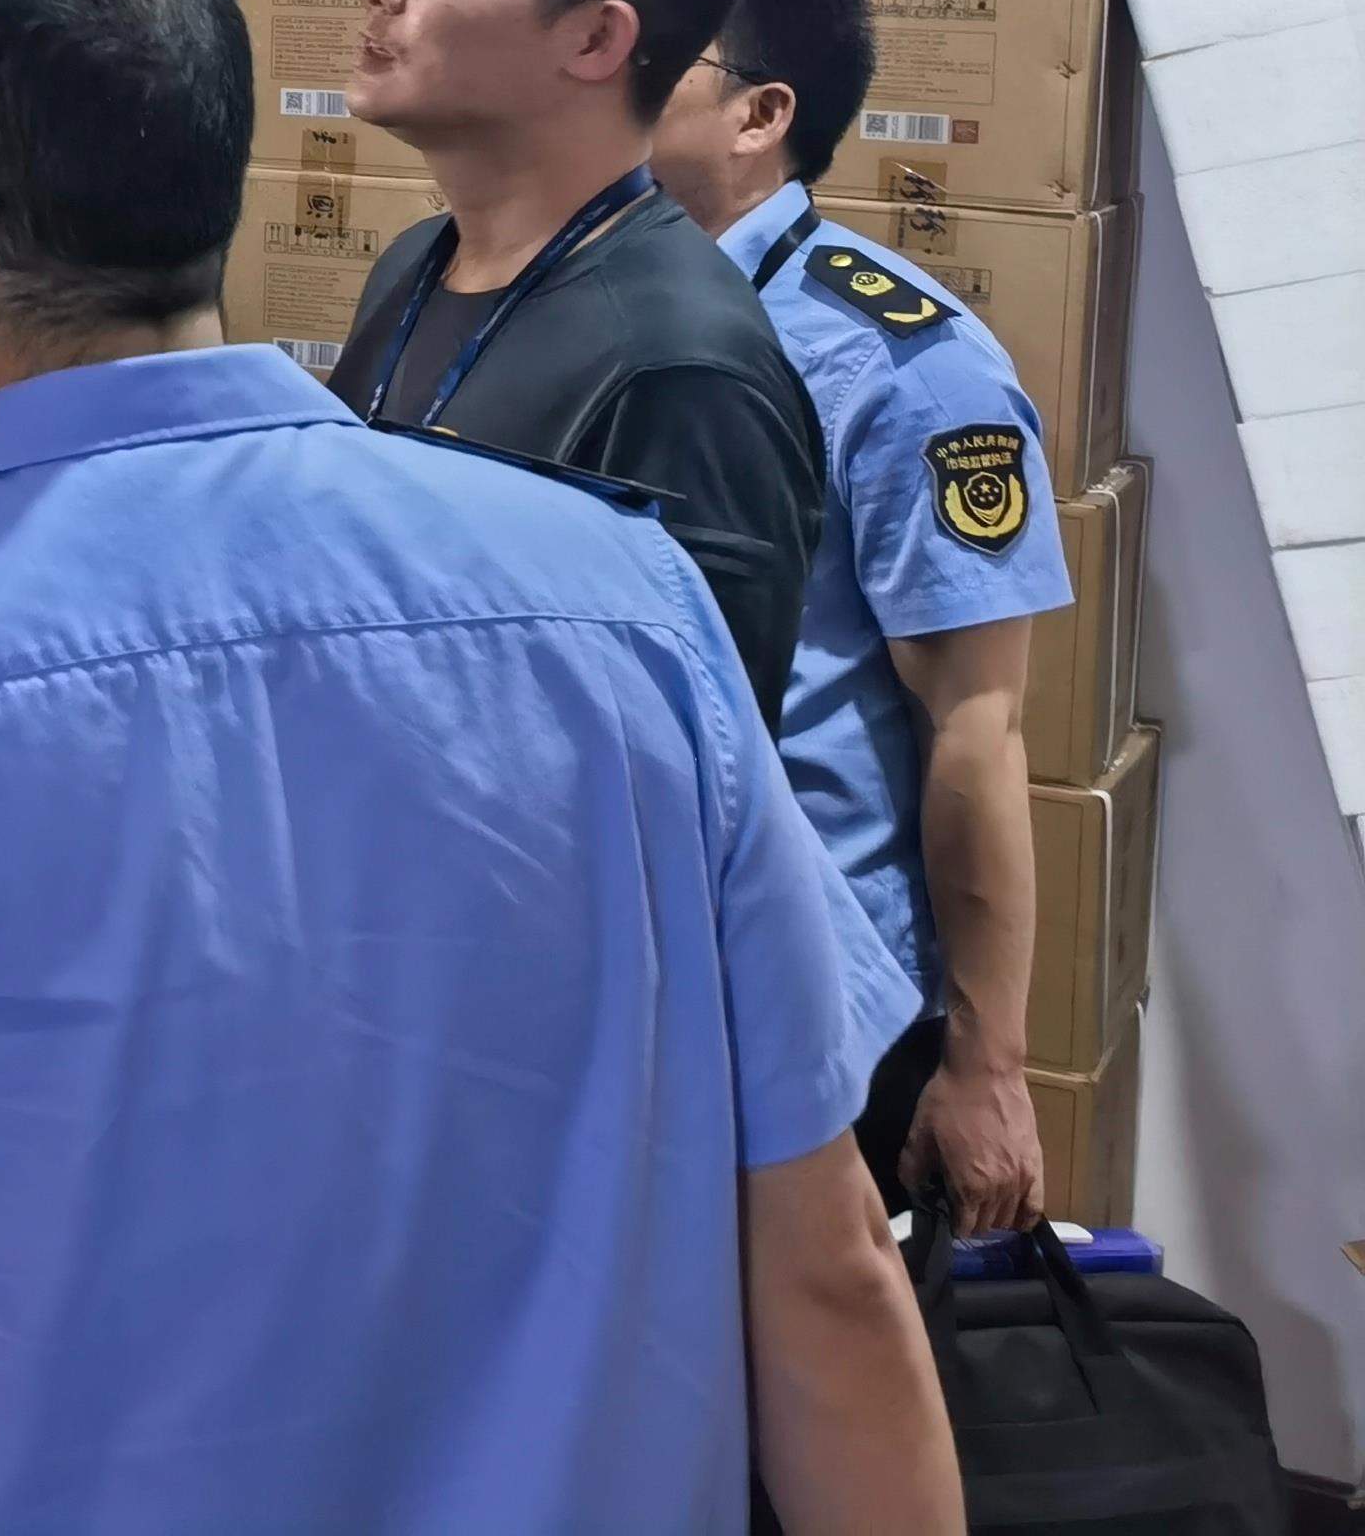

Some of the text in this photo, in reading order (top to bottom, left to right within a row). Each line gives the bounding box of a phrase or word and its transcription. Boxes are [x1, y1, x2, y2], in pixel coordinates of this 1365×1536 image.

[935, 434, 1020, 459] 中华人民共和国
